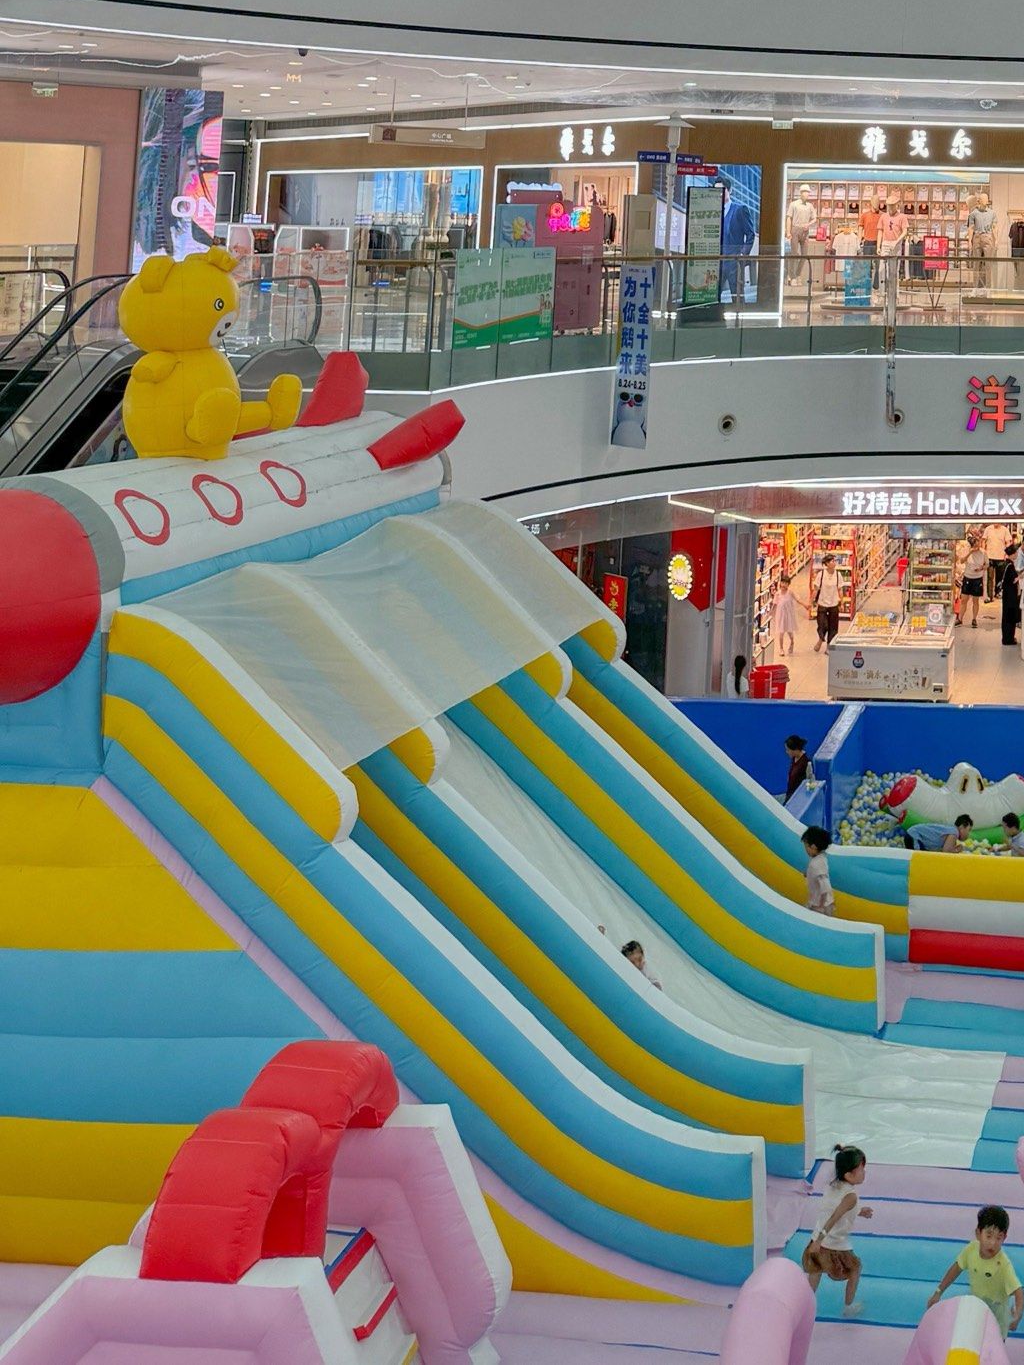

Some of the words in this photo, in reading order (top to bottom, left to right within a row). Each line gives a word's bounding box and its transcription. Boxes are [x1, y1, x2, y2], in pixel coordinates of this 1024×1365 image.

[861, 126, 974, 163] 雅戈尔
[619, 276, 637, 376] 为你鹅来
[633, 276, 652, 377] 十全十美
[617, 377, 647, 391] 8.24-8.25
[842, 490, 914, 517] 好特卖
[916, 490, 1024, 517] HotMaxx
